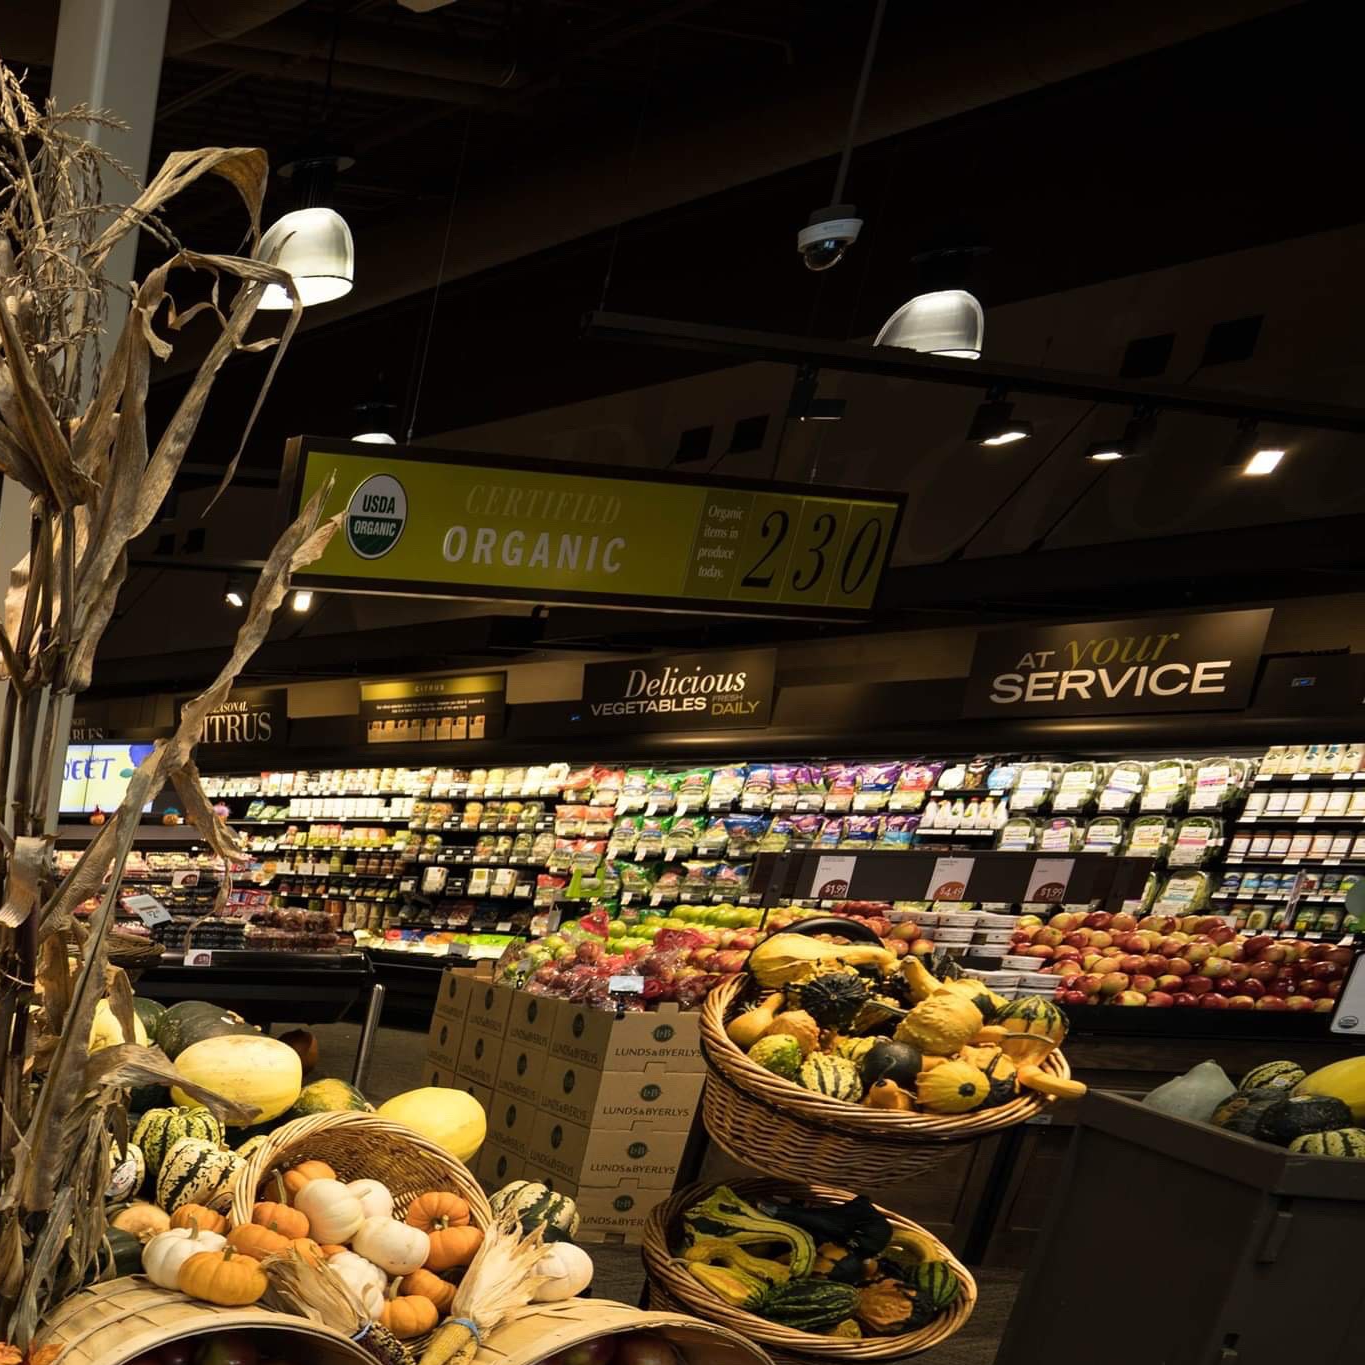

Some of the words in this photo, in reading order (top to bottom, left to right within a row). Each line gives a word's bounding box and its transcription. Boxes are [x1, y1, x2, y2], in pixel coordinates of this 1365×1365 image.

[362, 494, 395, 514] USDA
[464, 483, 622, 525] CERTIFIED
[708, 504, 744, 521] Organic
[353, 519, 397, 537] ORGANIC
[703, 523, 727, 538] items
[729, 525, 739, 539] in
[442, 525, 627, 574] ORGANIC
[696, 543, 735, 561] produce
[697, 563, 724, 580] today.
[1015, 649, 1056, 669] AT
[1054, 631, 1180, 683] your
[624, 666, 748, 699] Delicious
[989, 660, 1232, 704] SERVICE
[711, 693, 744, 703] FRESH
[591, 696, 708, 718] VEGETABLES
[711, 700, 761, 716] DAILY
[199, 712, 273, 745] ITRUS
[824, 884, 847, 896] $1.99
[940, 887, 963, 898] $4.49
[1040, 887, 1063, 899] $1.99
[614, 1047, 702, 1058] LUNDS&BYERLYS
[602, 1105, 690, 1118] LUNDS&BYERLYS
[589, 1163, 677, 1175] LUNDS&BYERLYS
